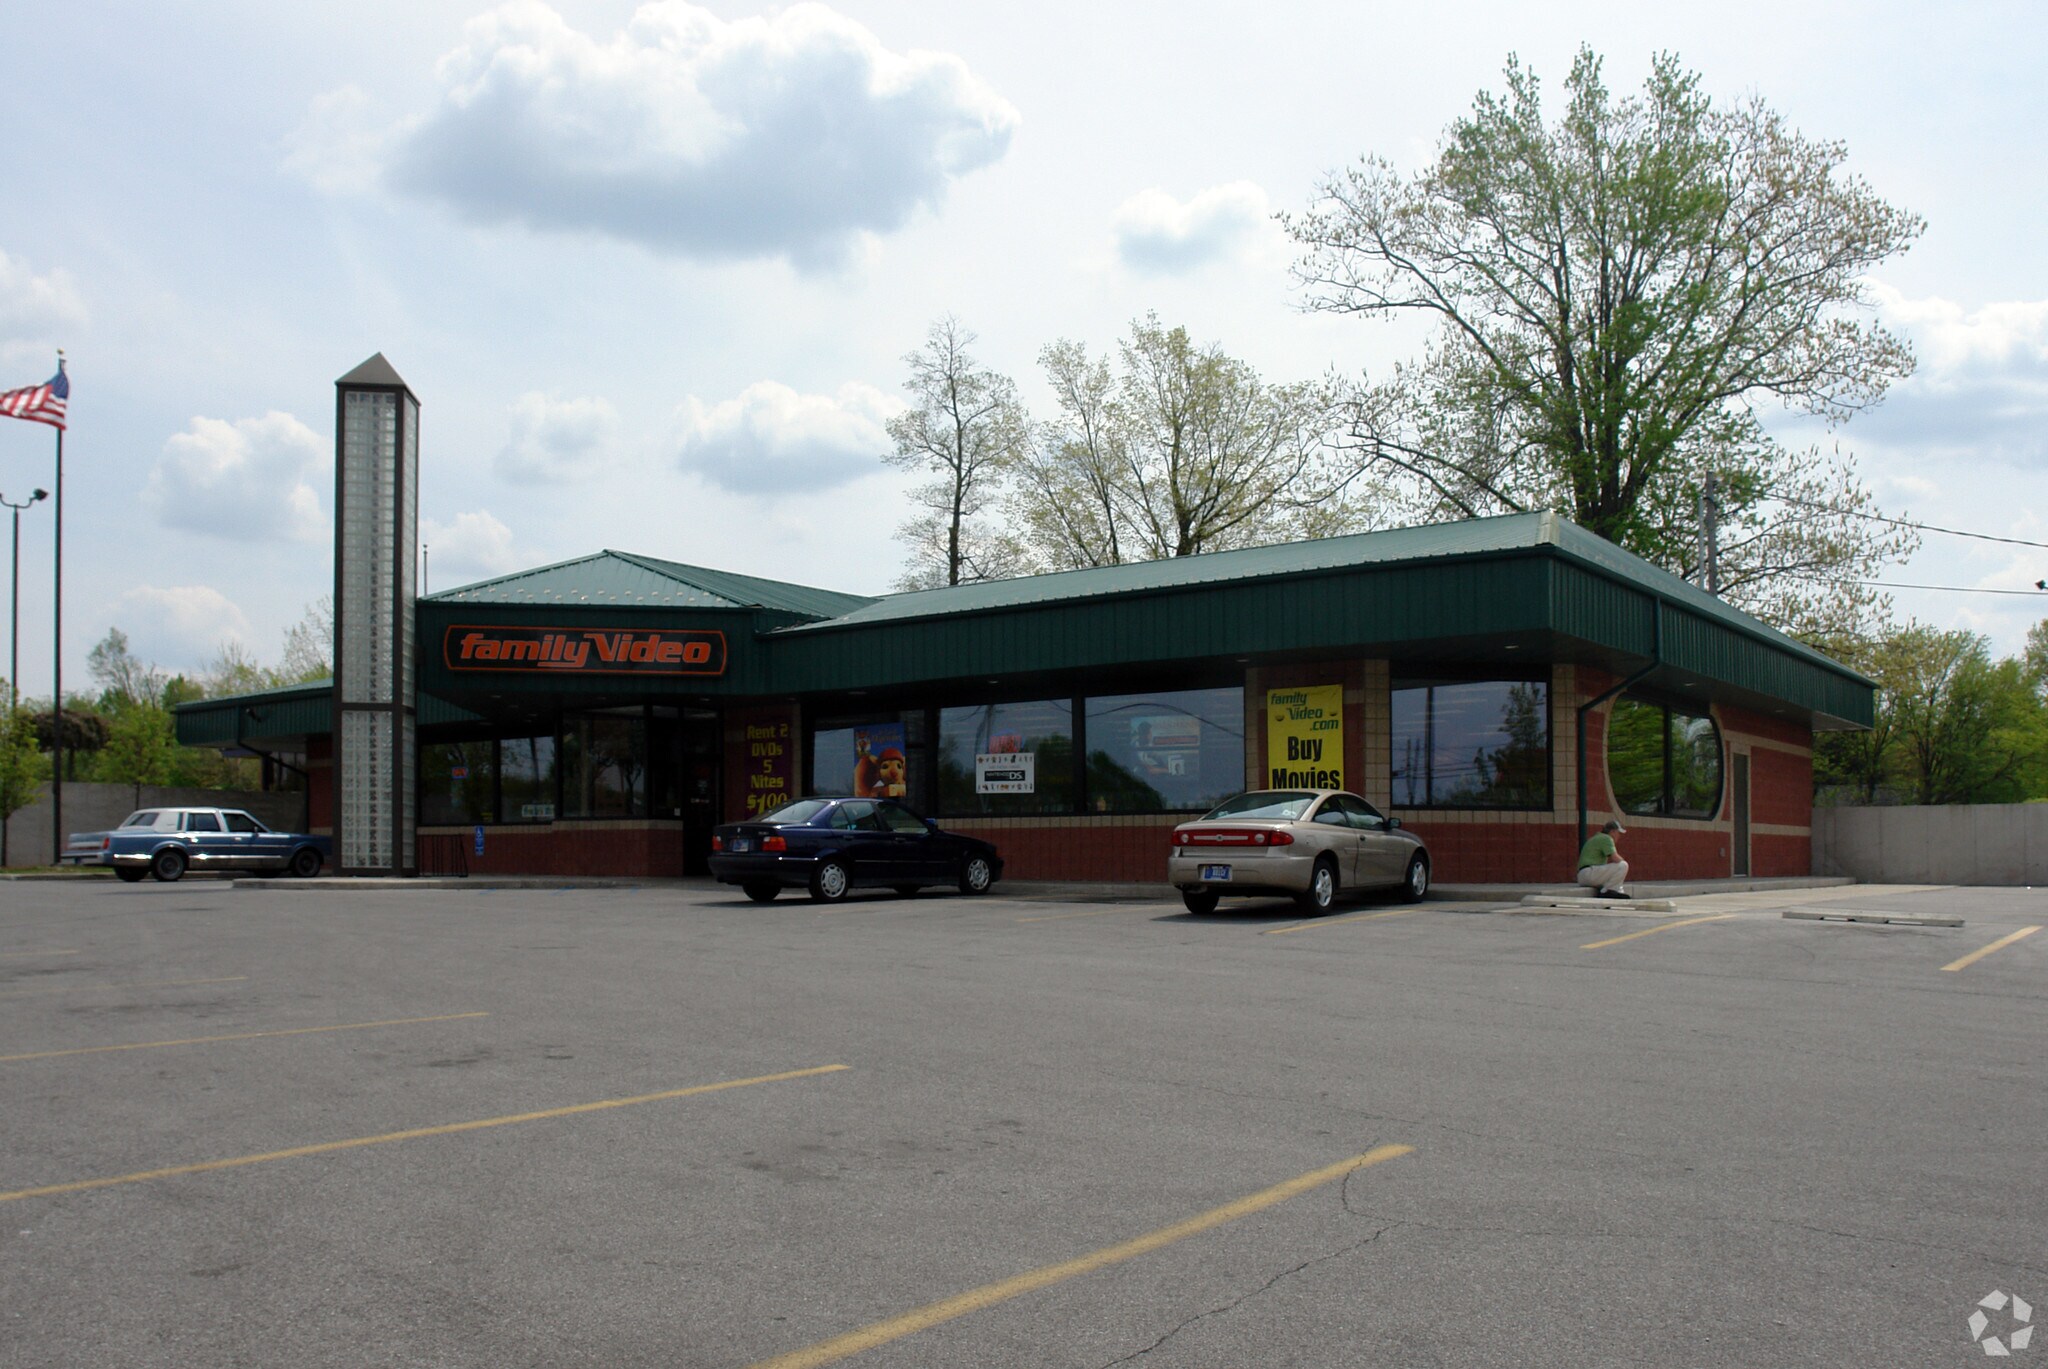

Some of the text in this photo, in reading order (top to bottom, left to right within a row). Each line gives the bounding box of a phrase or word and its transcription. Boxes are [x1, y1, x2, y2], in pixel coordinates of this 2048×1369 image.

[1271, 692, 1307, 706] family
[1286, 707, 1323, 720] Video
[747, 723, 788, 739] Rent 2
[1309, 720, 1339, 731] .com
[752, 742, 783, 756] DVDs
[1287, 736, 1323, 762] Buy
[763, 760, 772, 773] 5
[751, 774, 784, 789] Nites
[1009, 771, 1023, 780] DS
[1272, 767, 1341, 790] Movies
